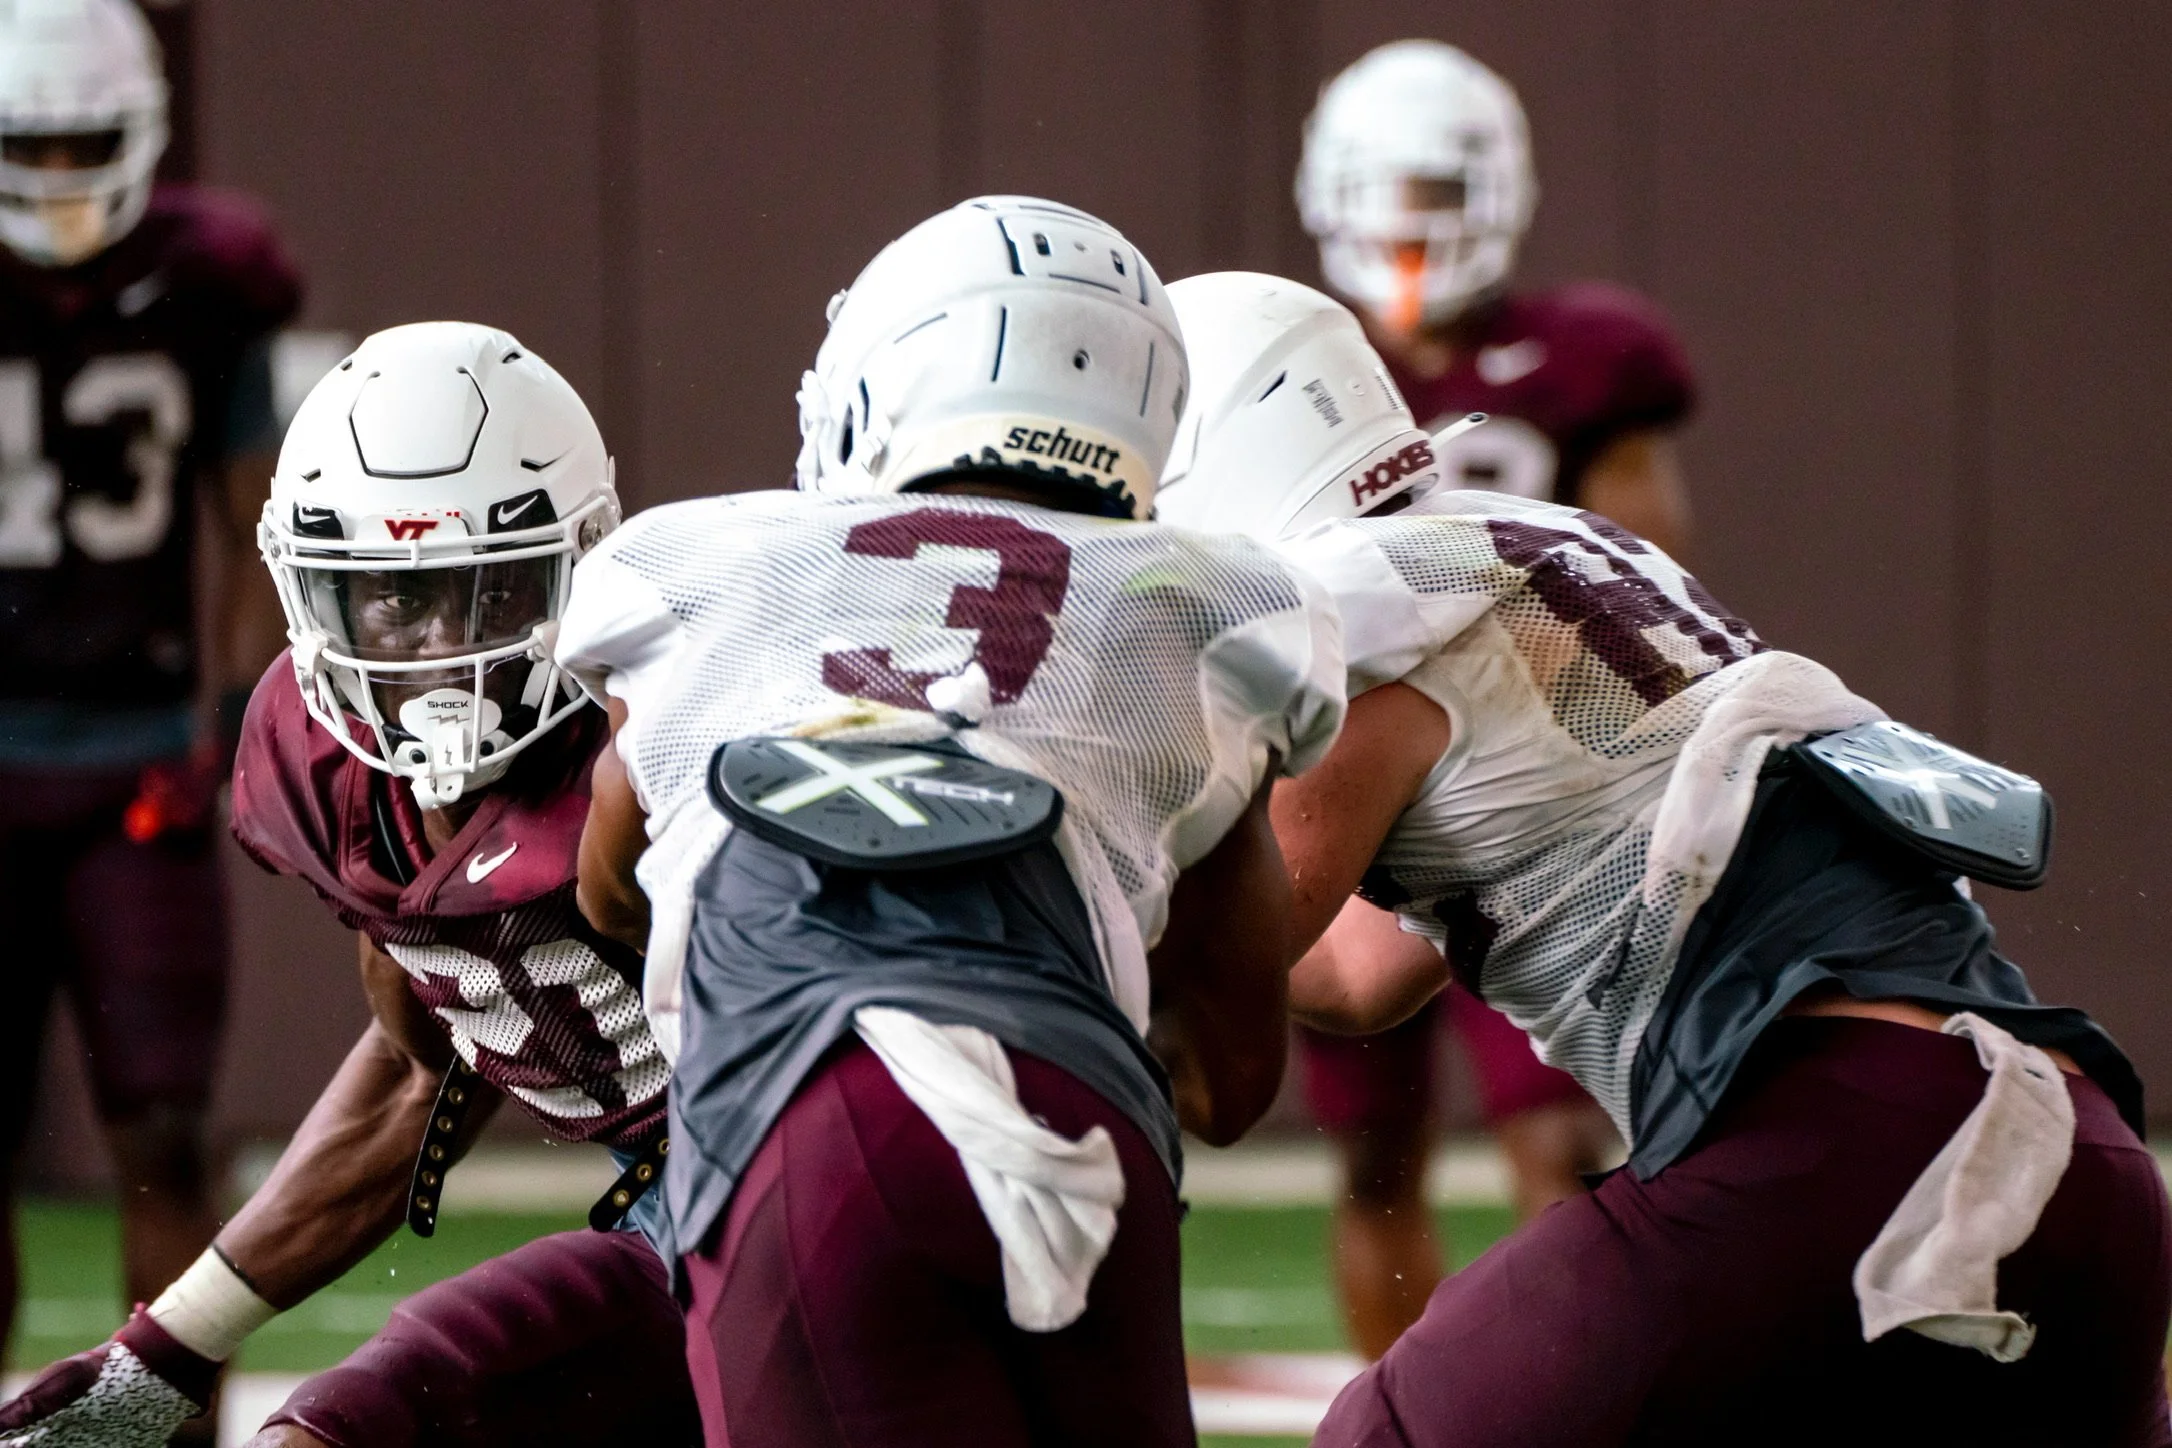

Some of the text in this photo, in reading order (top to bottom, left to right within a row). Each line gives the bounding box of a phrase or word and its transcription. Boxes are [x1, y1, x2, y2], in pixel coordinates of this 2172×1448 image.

[1004, 425, 1120, 475] schutt
[383, 519, 440, 541] VT
[822, 507, 1072, 711] 3
[427, 700, 469, 710] SHOCK
